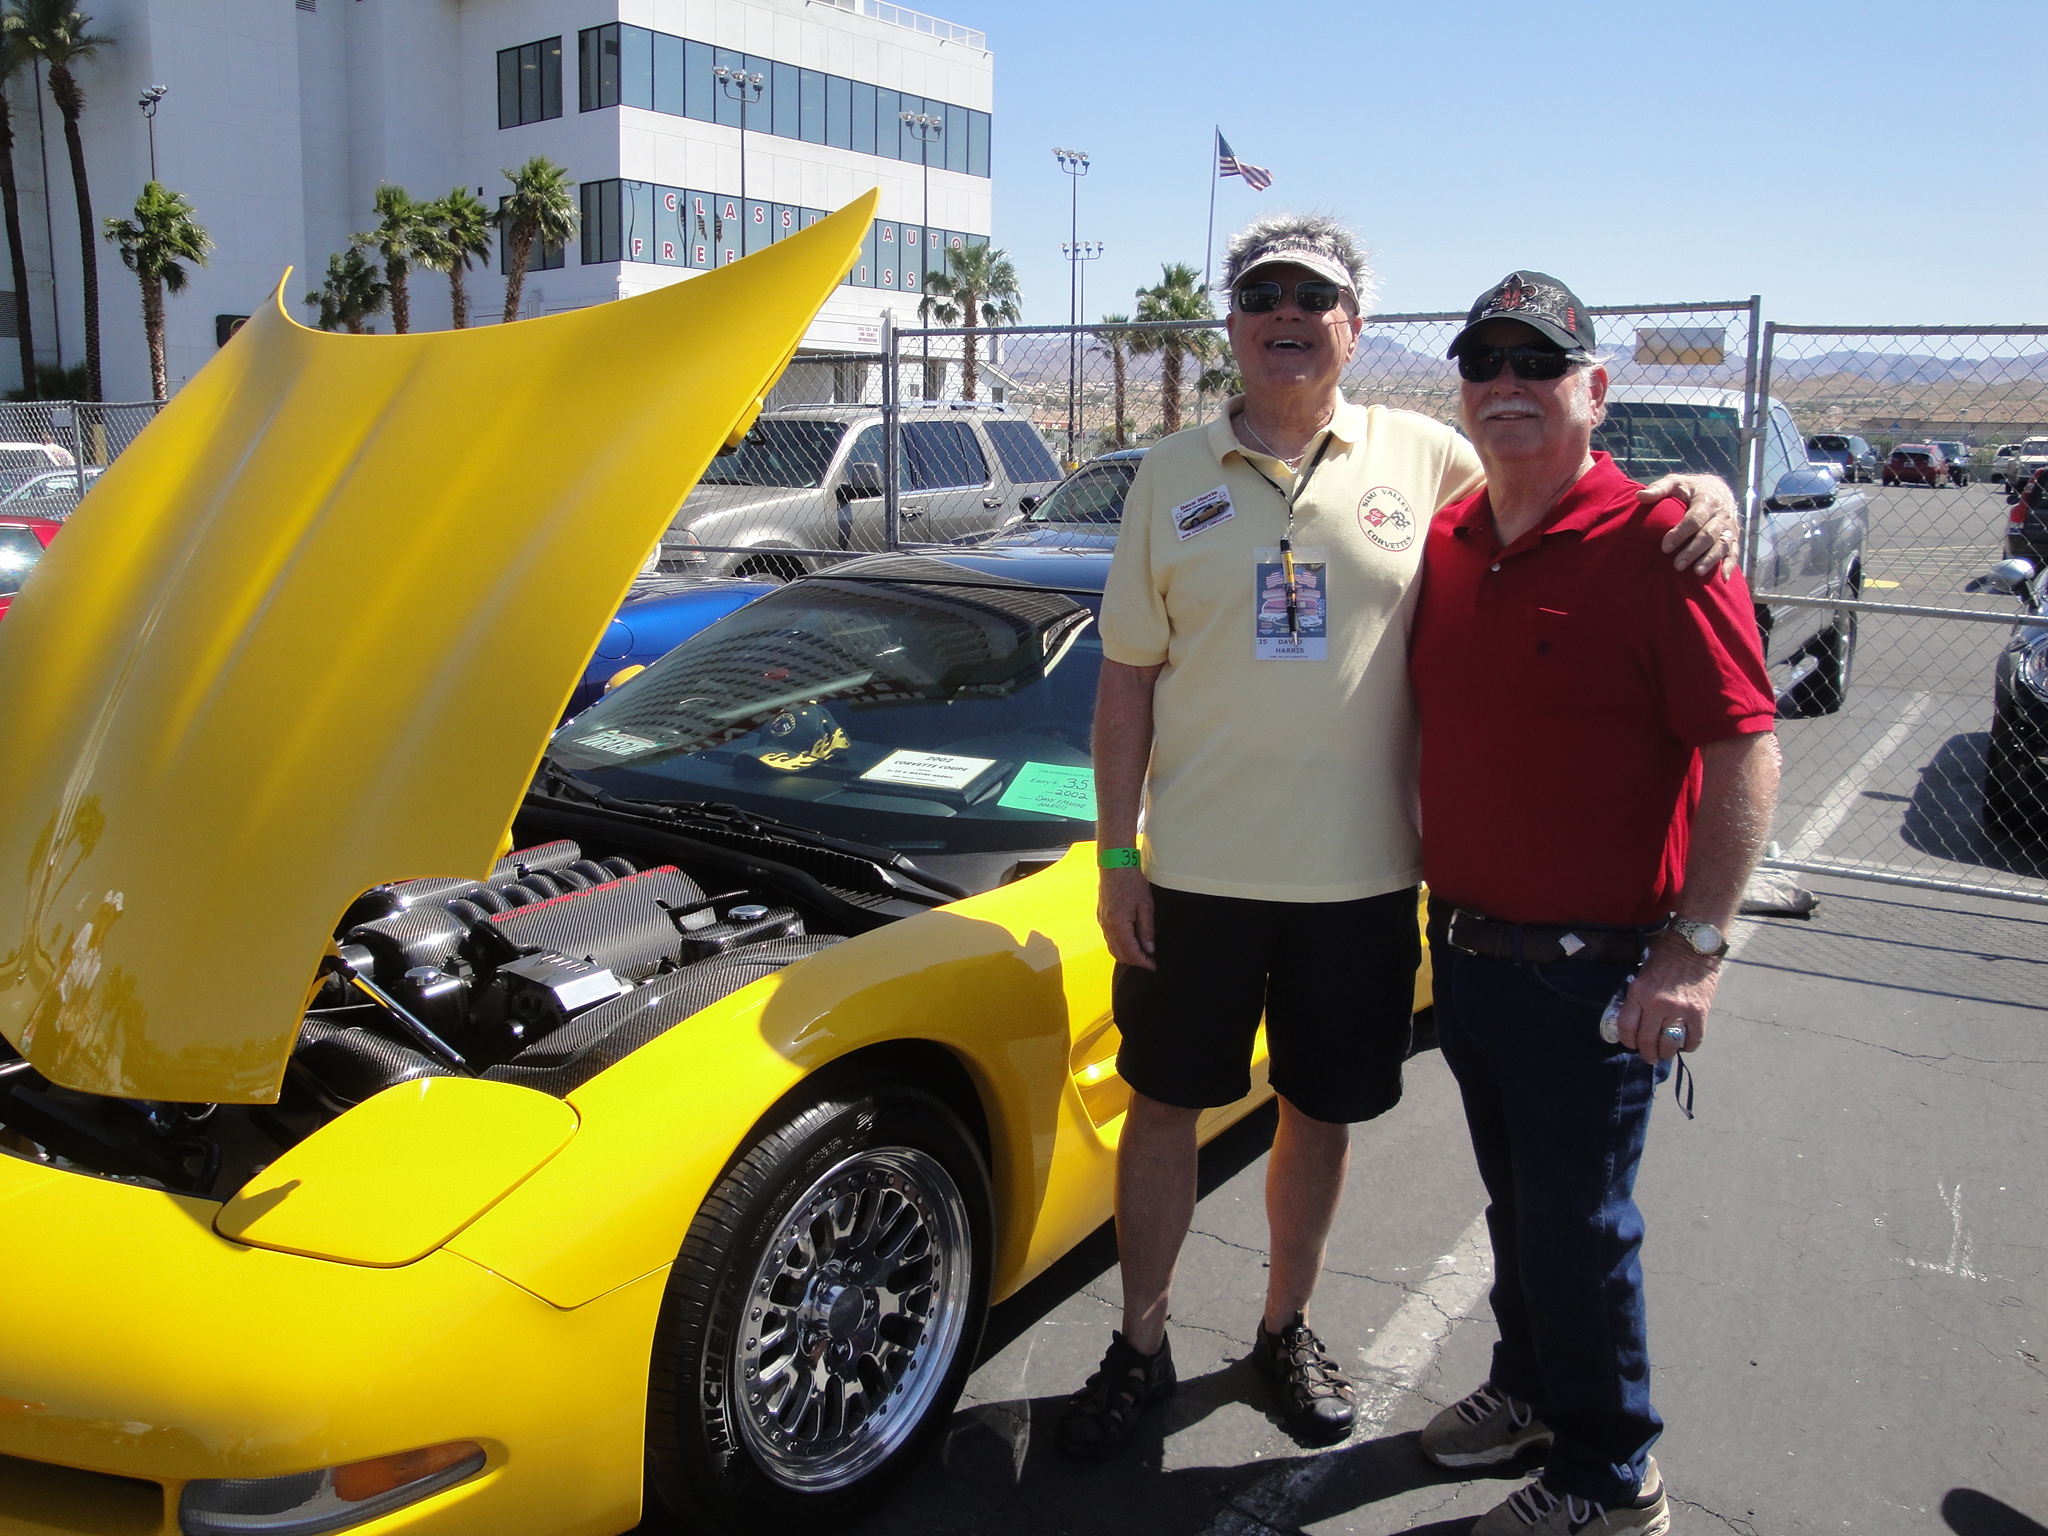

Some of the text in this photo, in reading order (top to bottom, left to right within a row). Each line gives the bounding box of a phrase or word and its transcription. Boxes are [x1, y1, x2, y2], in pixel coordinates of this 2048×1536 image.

[664, 194, 962, 250] CLASSI AUTO
[633, 238, 916, 287] FREE ISS
[1362, 489, 1410, 512] SIMI VALLEY
[1367, 529, 1411, 549] CORVETTES
[894, 760, 938, 769] CORVETTE
[1063, 777, 1090, 790] 35
[1054, 789, 1088, 800] 2002
[1121, 849, 1138, 867] 35
[491, 864, 680, 922] CORVETTE
[703, 1256, 740, 1455] MICHELIN
